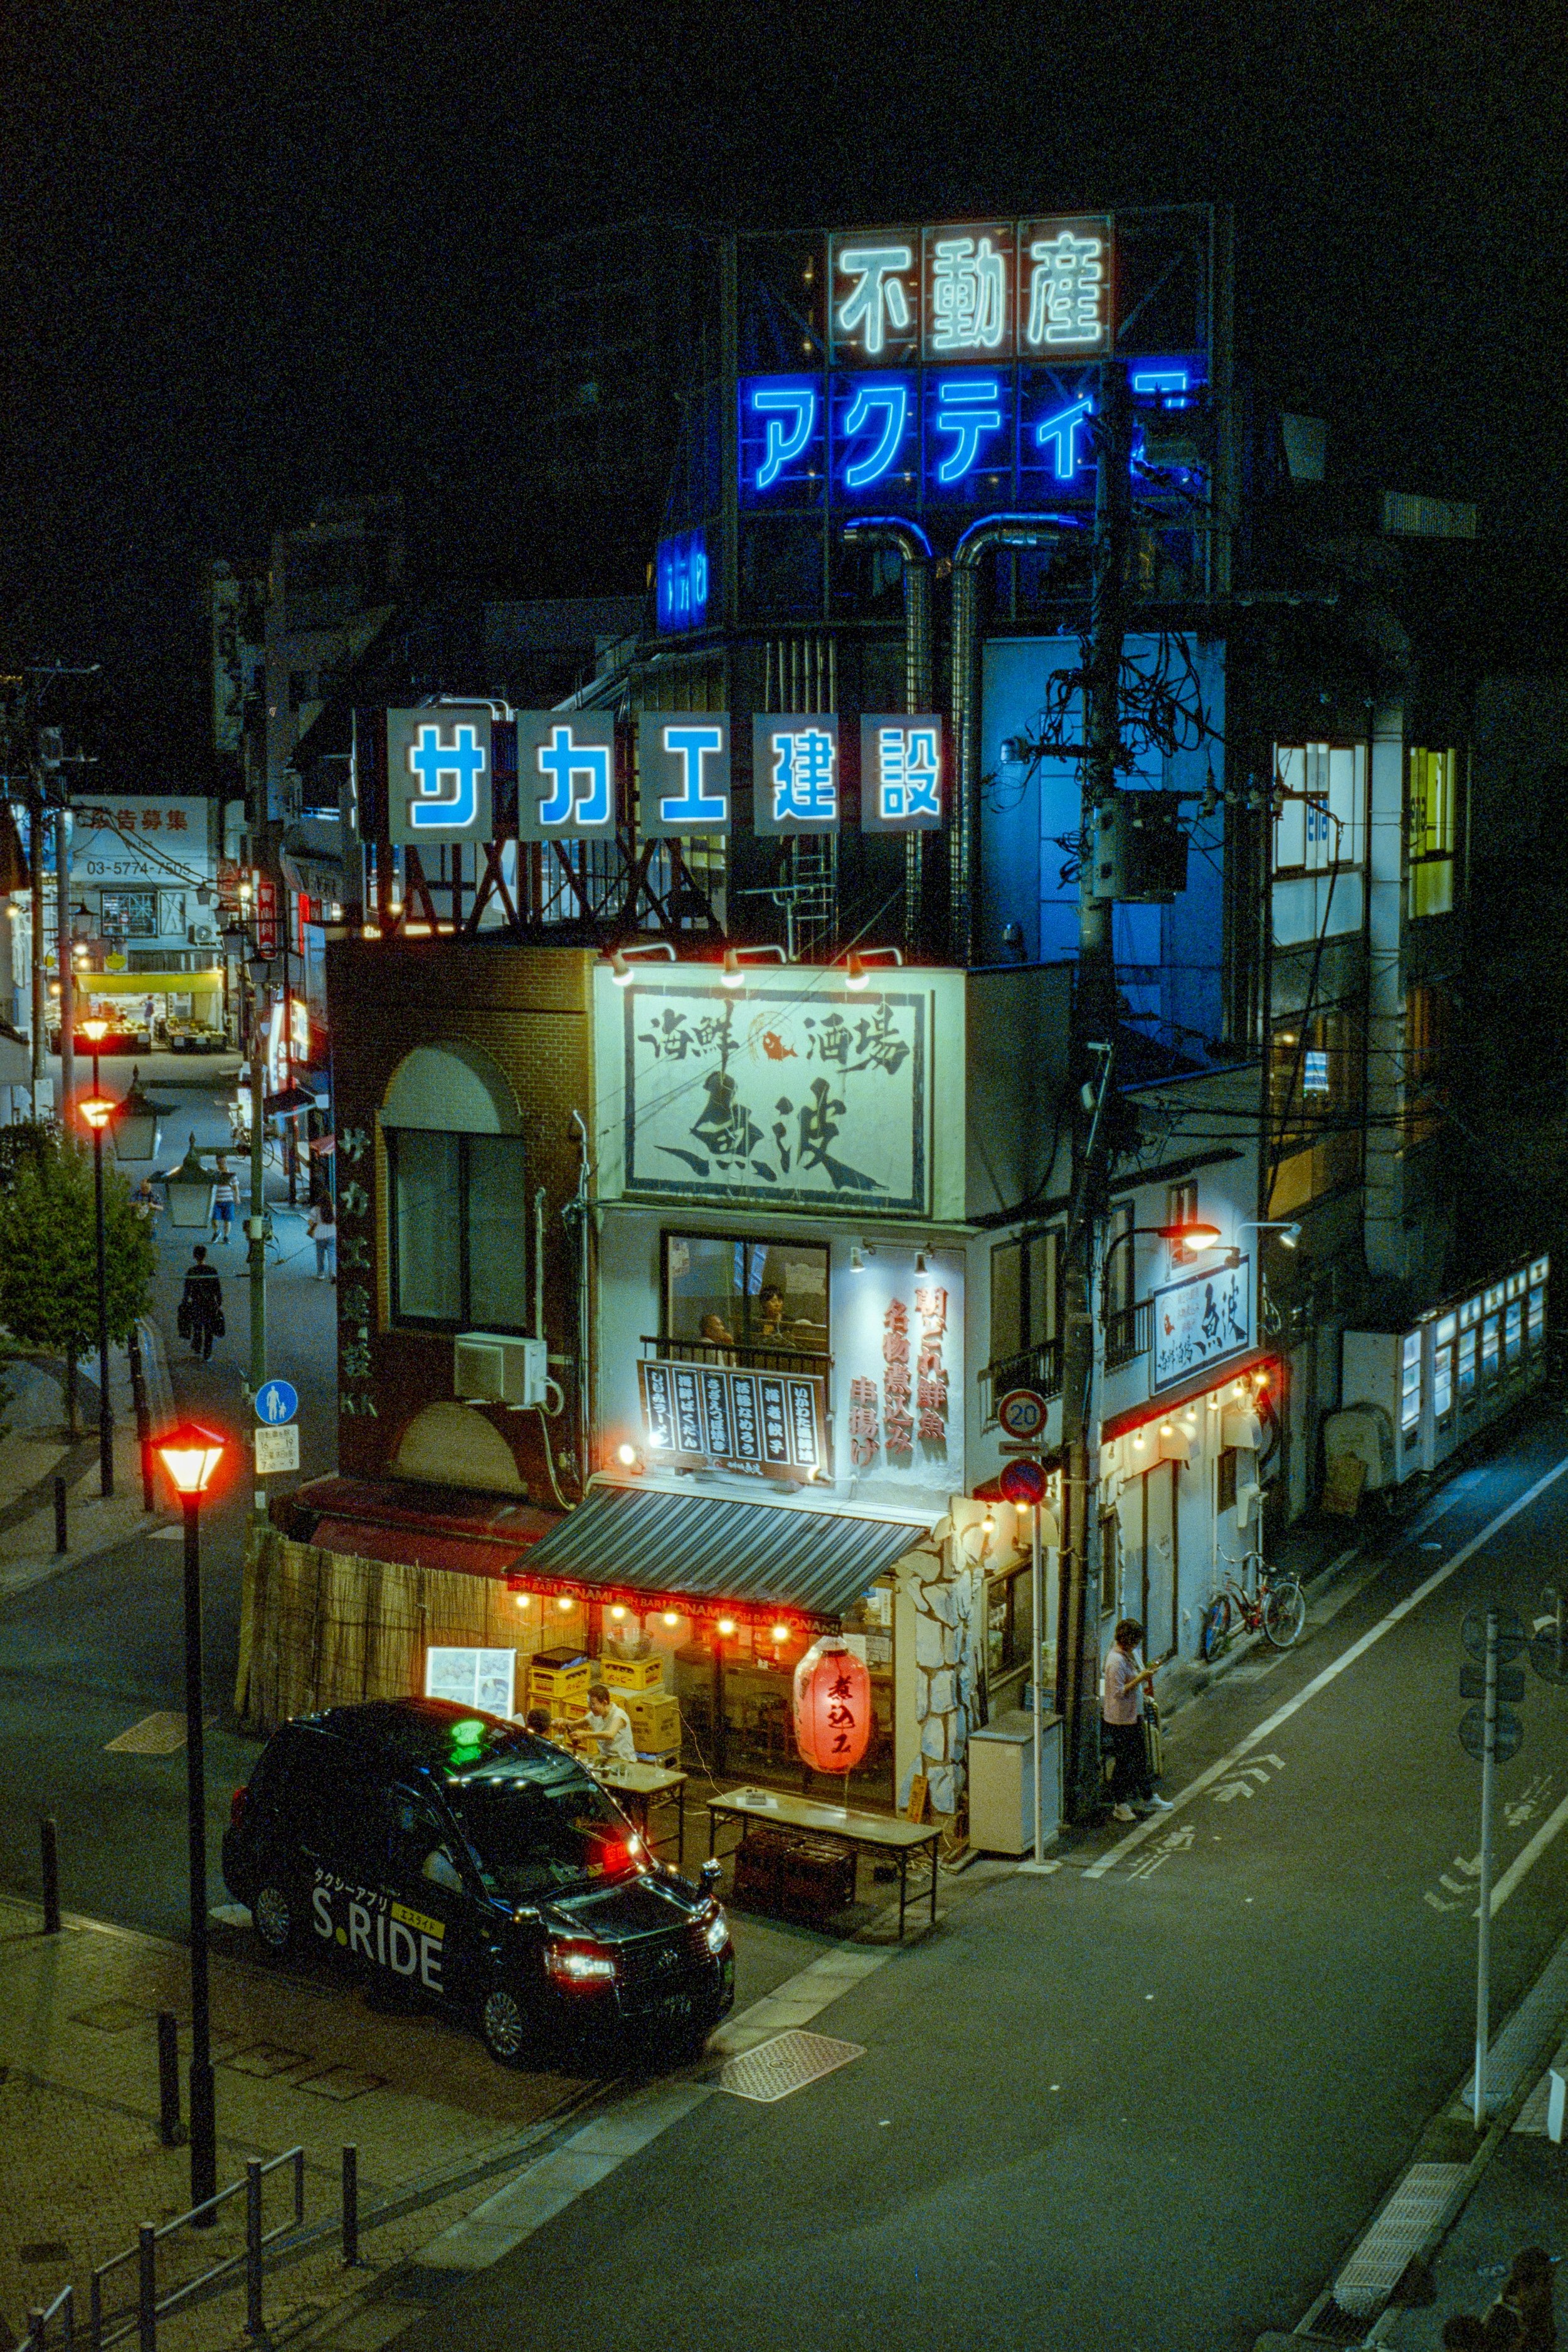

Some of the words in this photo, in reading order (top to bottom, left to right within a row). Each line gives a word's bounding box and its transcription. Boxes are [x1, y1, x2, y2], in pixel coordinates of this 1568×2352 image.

[838, 231, 1102, 354] 不動産
[410, 725, 940, 828] サカエ建設
[637, 999, 740, 1069] 海鮮
[803, 1002, 910, 1075] 酒場
[653, 1070, 890, 1191] 魚波
[1192, 1273, 1247, 1357] 魚波
[849, 1375, 879, 1468] 串揚げ
[882, 1298, 914, 1455] 名物煮込み
[1010, 1404, 1037, 1426] 20
[315, 1867, 388, 1912] タクシーアプリ
[400, 1909, 435, 1931] エスライド
[313, 1887, 444, 1993] S.RIDE
